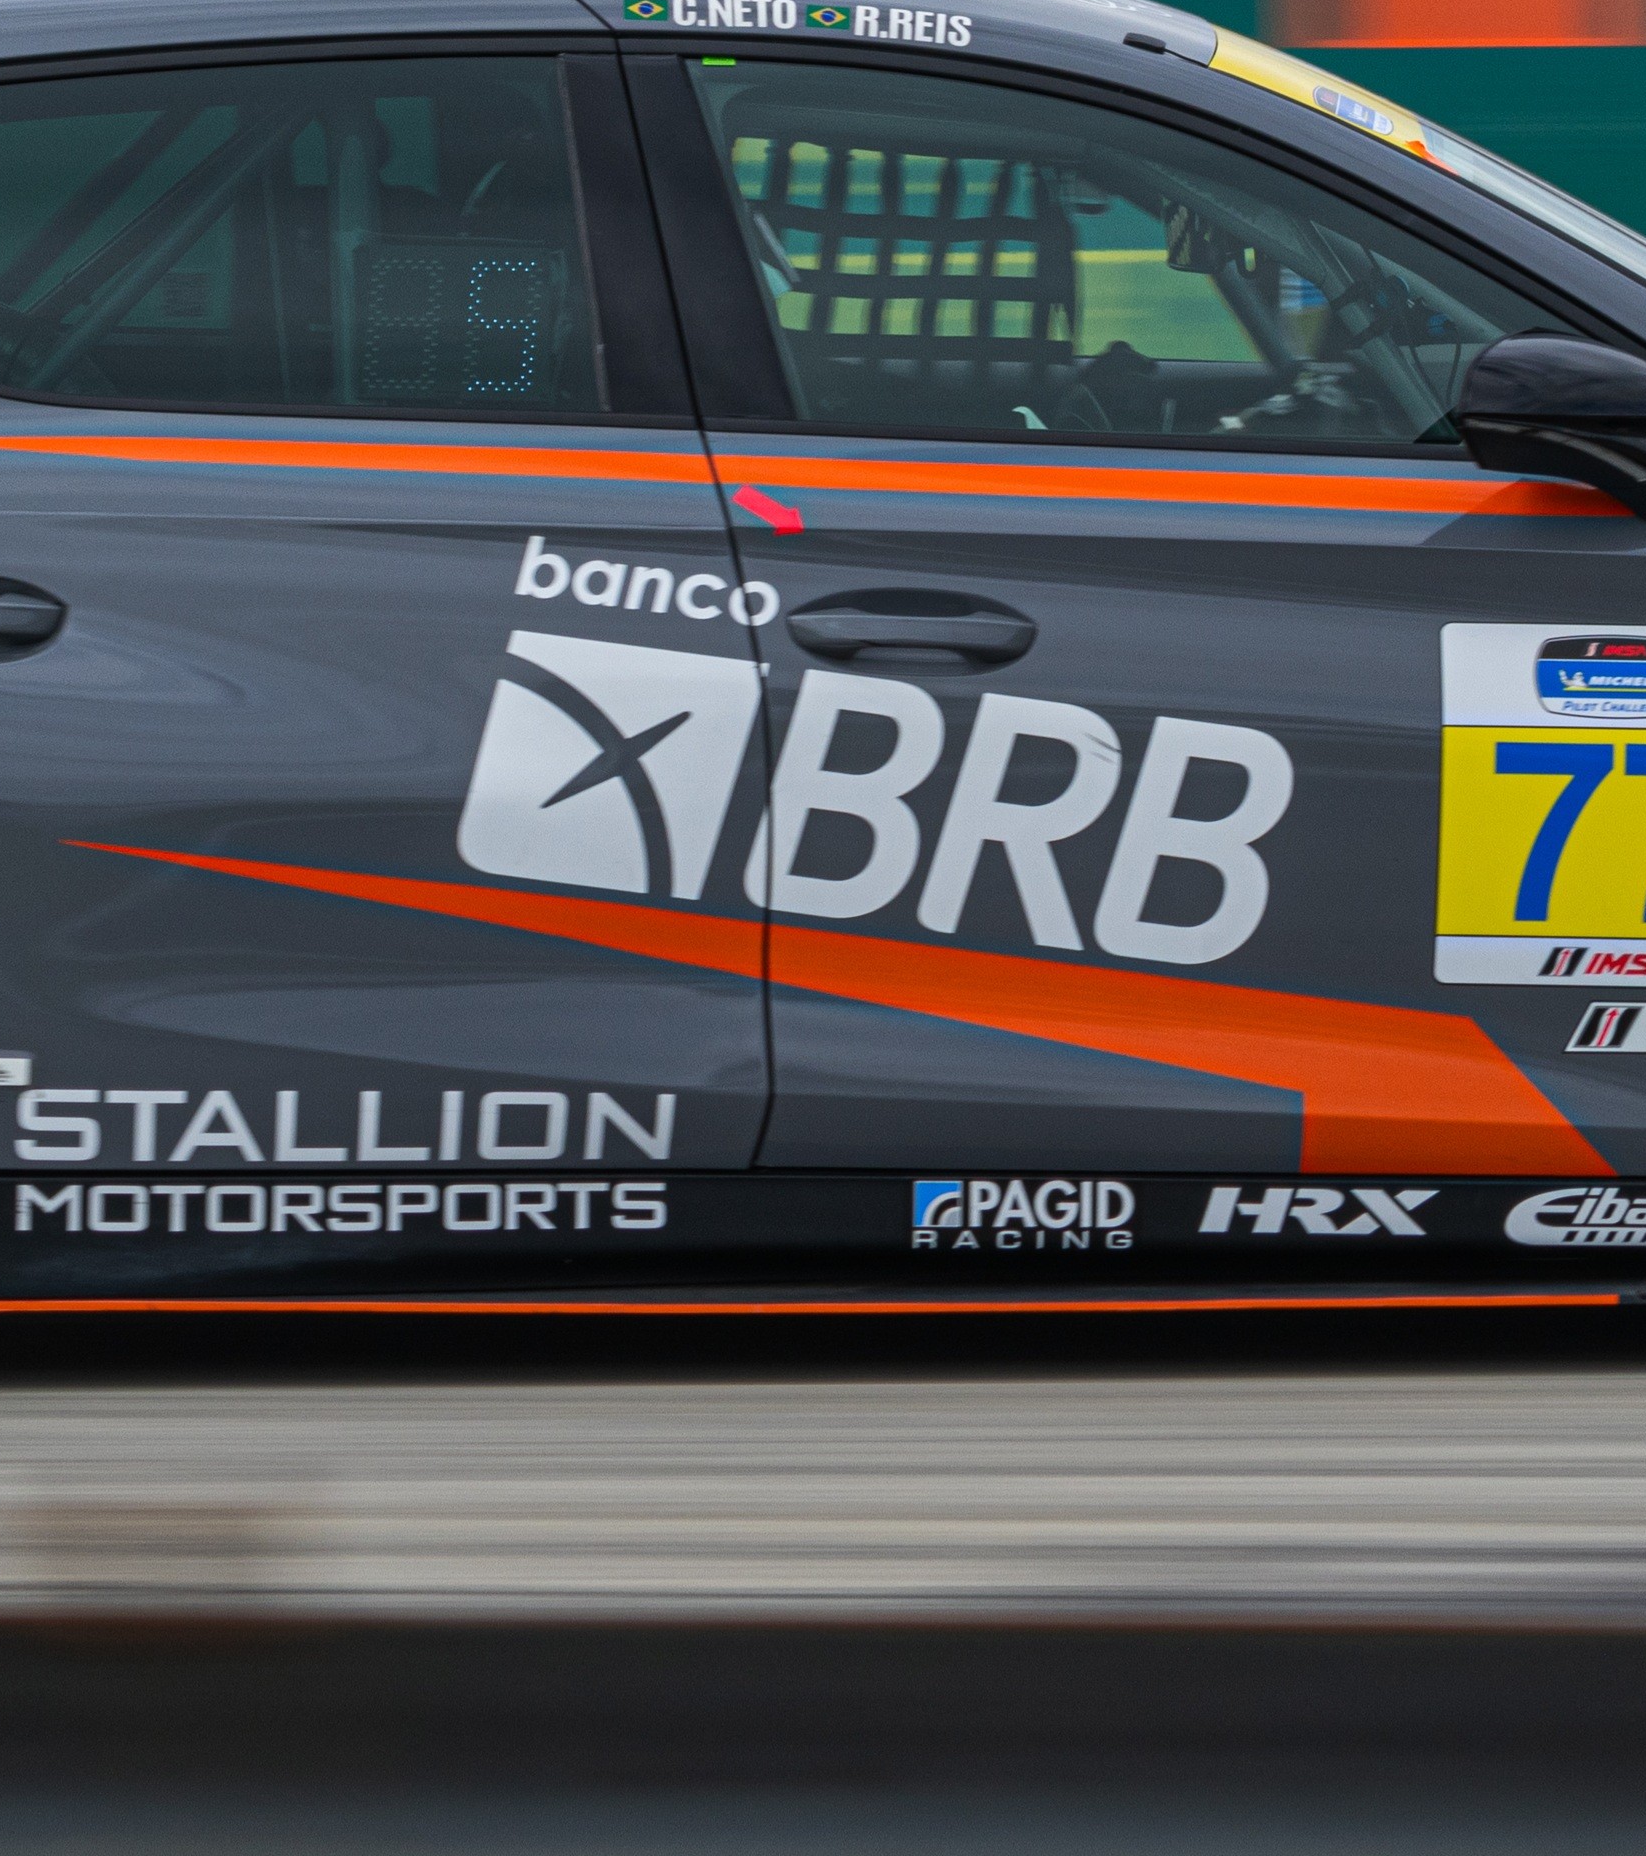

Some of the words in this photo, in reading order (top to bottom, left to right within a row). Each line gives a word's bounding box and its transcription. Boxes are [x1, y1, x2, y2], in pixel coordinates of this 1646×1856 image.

[854, 5, 973, 47] R.REIS
[513, 535, 781, 627] banco
[742, 668, 1294, 966] BRB
[14, 1089, 678, 1162] STALLION
[14, 1184, 667, 1233] MOTORSPORTS
[965, 1179, 1136, 1231] PAGID
[1197, 1186, 1441, 1236] HRX
[912, 1230, 1134, 1249] RACING
